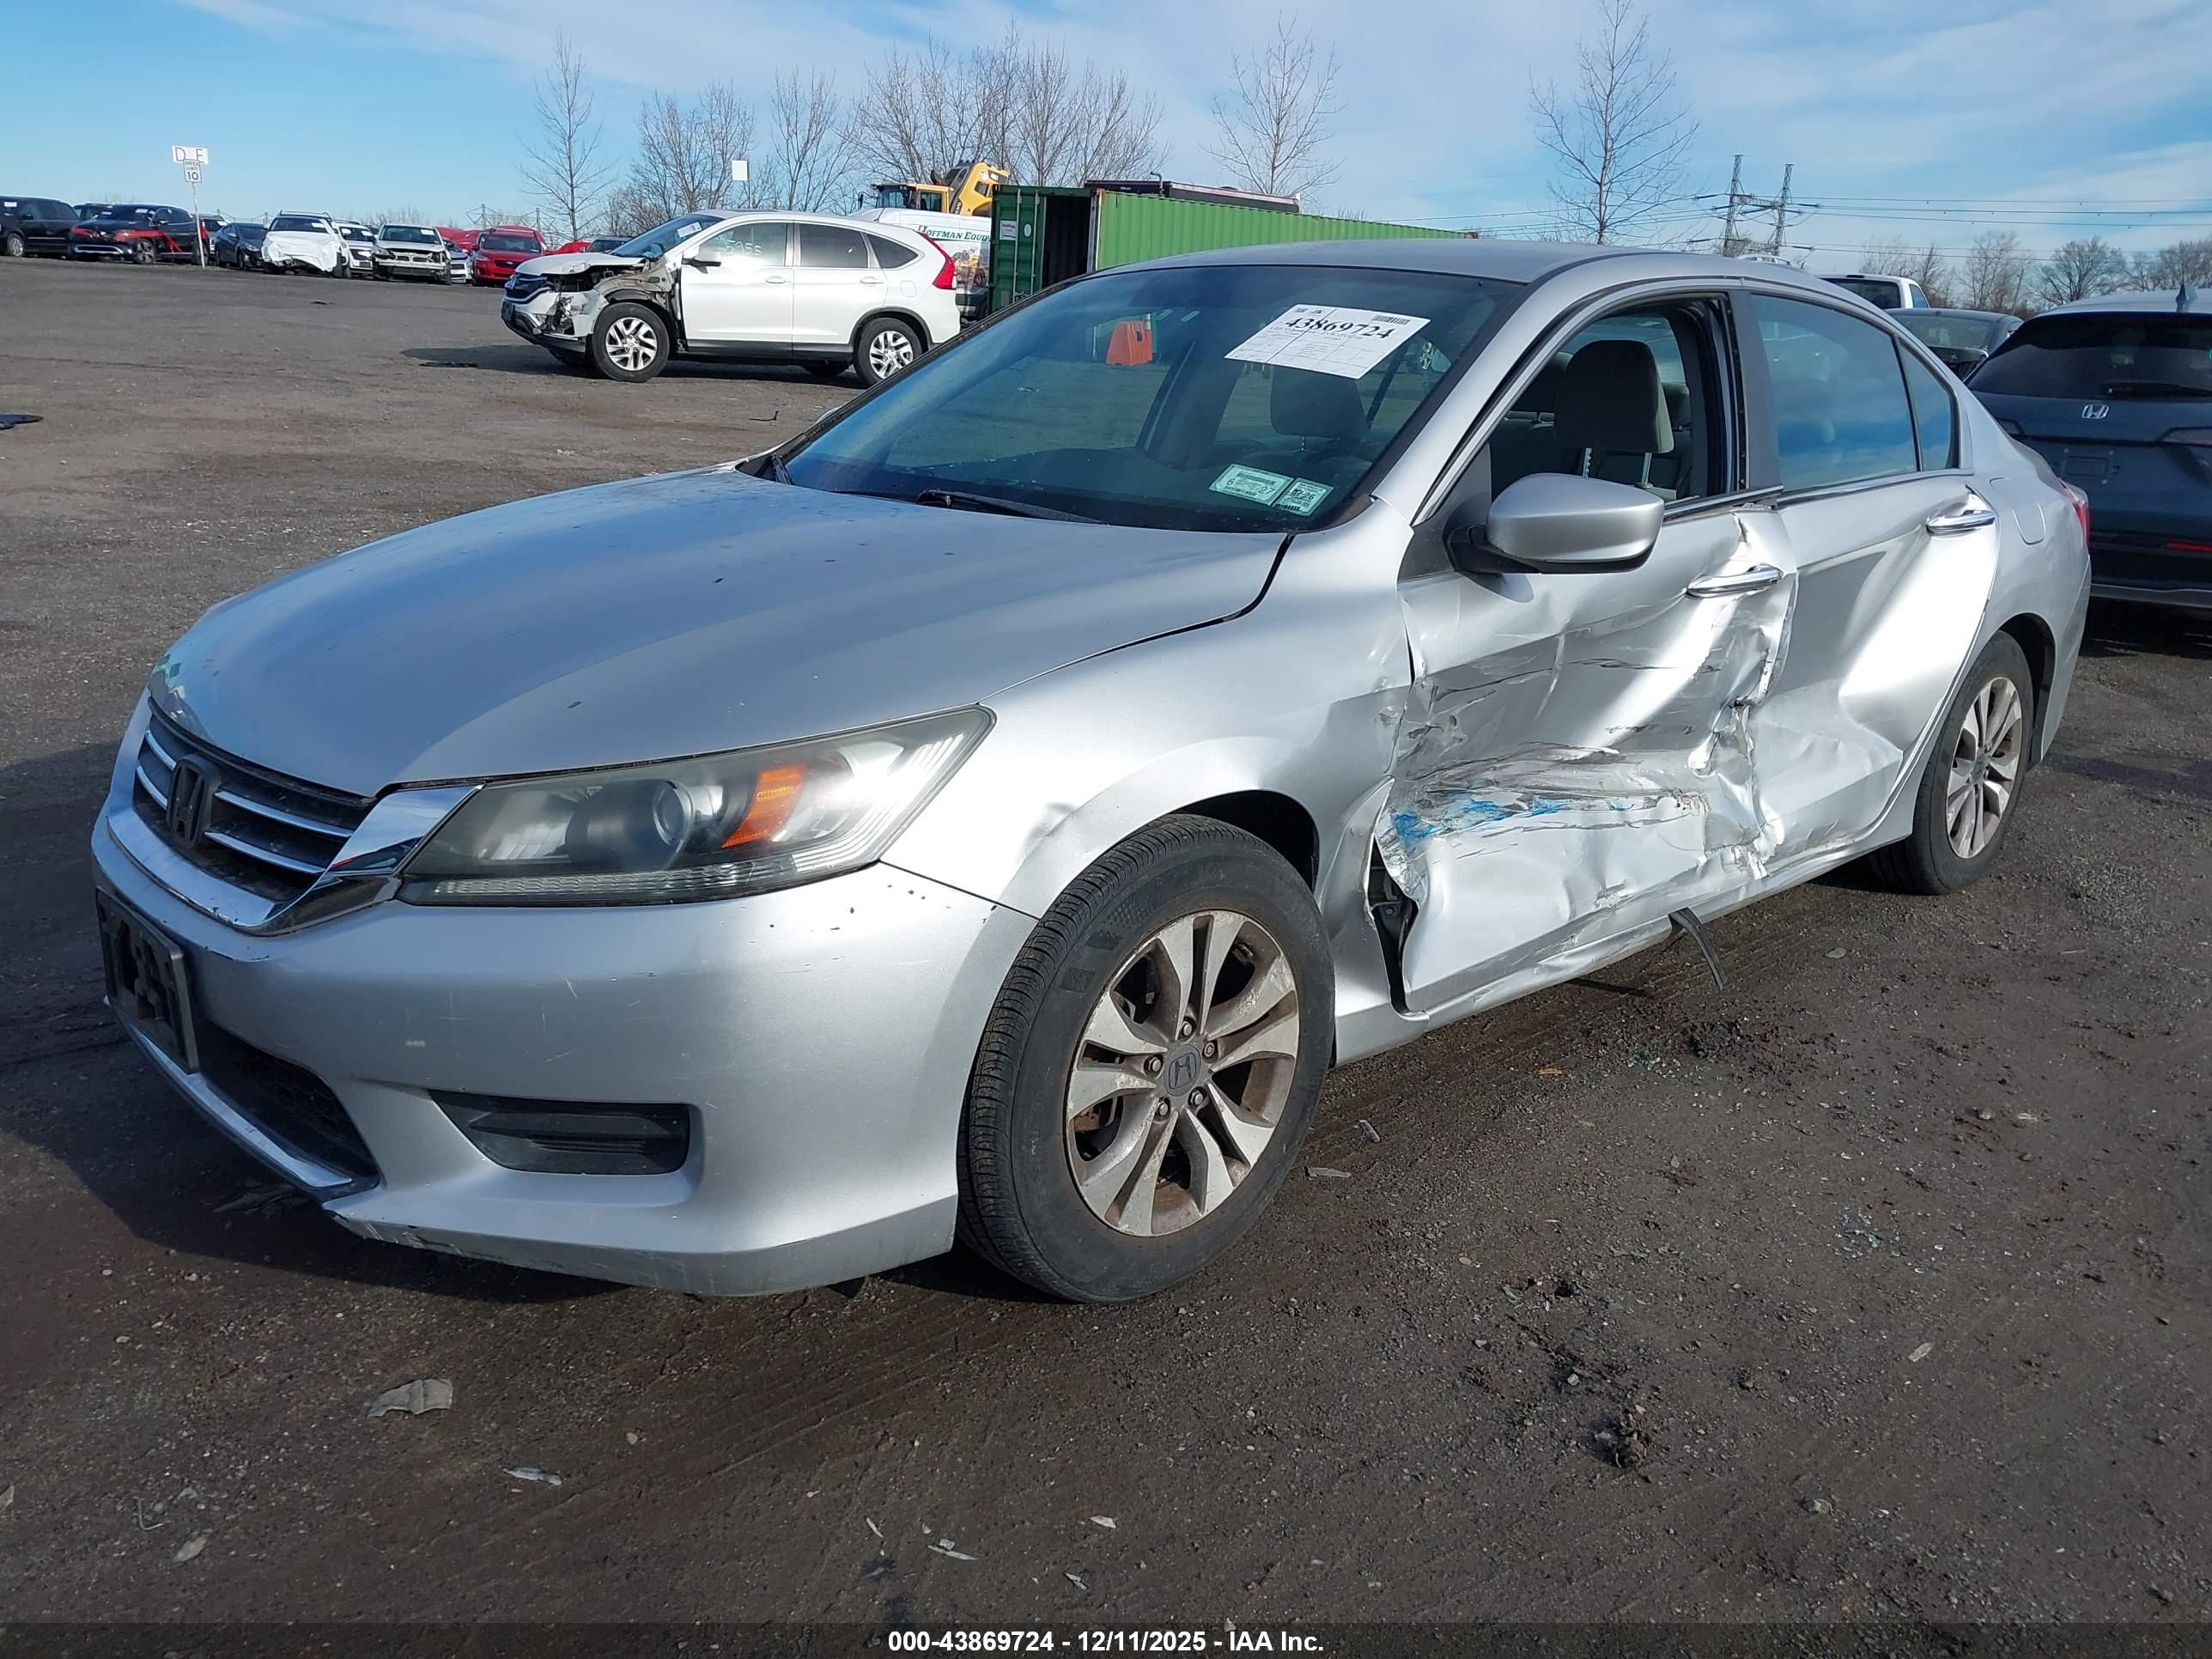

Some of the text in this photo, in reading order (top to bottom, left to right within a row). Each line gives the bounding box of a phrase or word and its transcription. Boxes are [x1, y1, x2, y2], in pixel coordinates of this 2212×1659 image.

[174, 147, 186, 161] D
[187, 171, 199, 180] 10
[917, 225, 963, 239] HOFFMAN
[1285, 316, 1396, 339] 43869724
